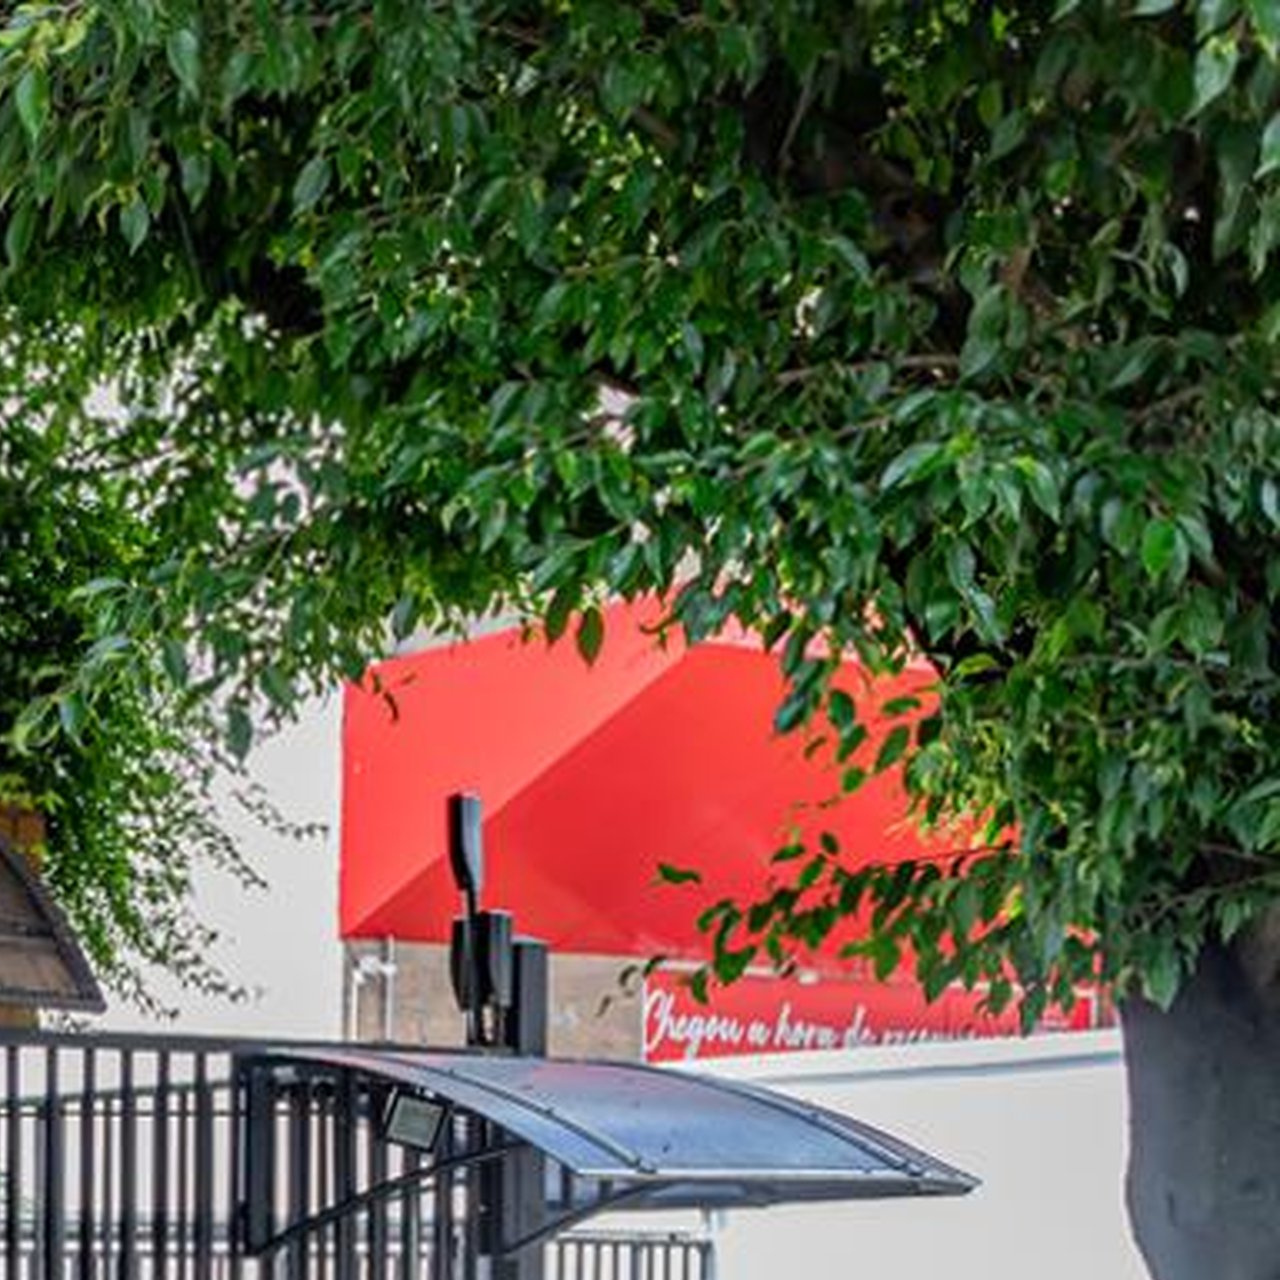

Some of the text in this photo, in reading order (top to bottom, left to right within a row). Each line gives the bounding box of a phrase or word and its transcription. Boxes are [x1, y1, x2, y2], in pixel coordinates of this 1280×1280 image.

[644, 988, 742, 1055] Chegou
[746, 1019, 770, 1046] a
[775, 1000, 836, 1049] hora
